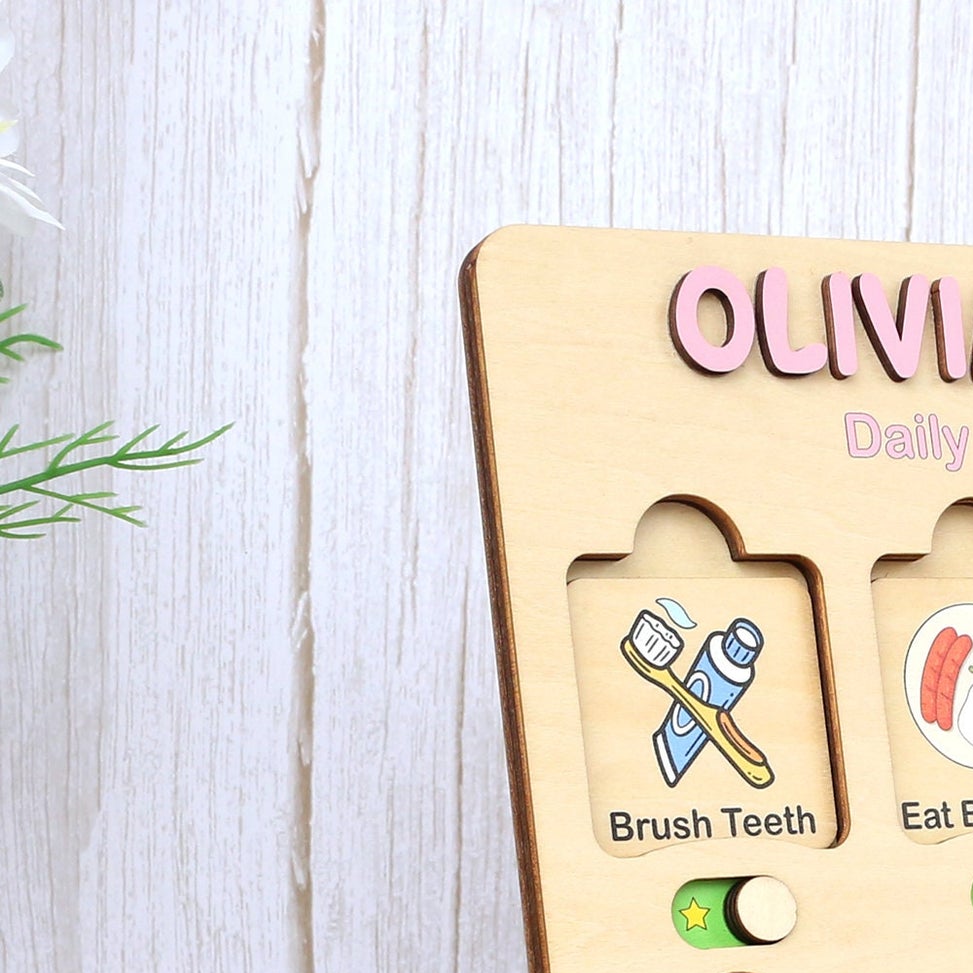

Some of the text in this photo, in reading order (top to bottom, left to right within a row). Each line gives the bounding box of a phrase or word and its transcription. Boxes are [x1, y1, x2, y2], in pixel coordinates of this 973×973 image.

[844, 412, 969, 472] Daily
[609, 805, 816, 842] Brush Teeth
[901, 801, 955, 830] Eat
